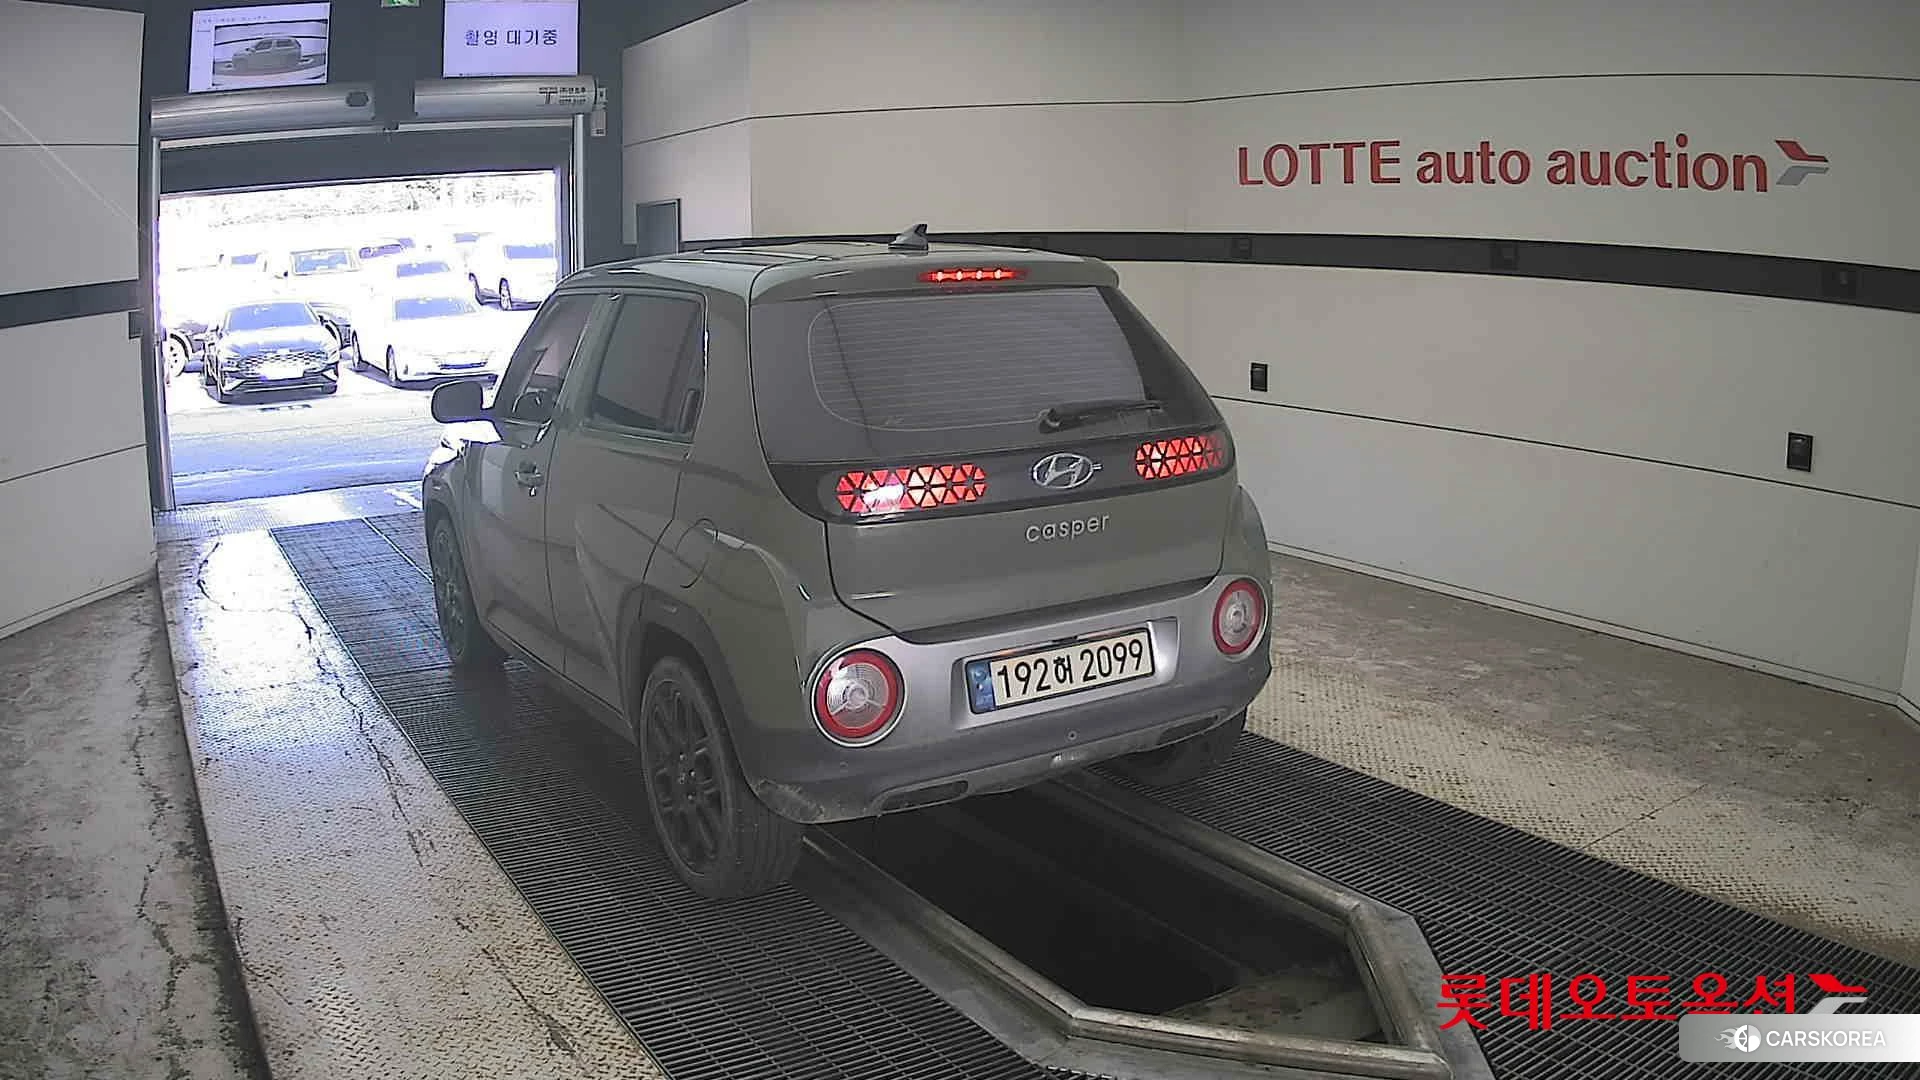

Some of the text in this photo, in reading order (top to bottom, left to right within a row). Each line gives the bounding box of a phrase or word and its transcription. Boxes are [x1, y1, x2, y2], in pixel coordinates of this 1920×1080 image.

[507, 30, 557, 46] 대기중
[1239, 134, 1767, 193] LOTTE auto auction
[1026, 514, 1109, 542] casper
[997, 638, 1143, 697] 192허 2099
